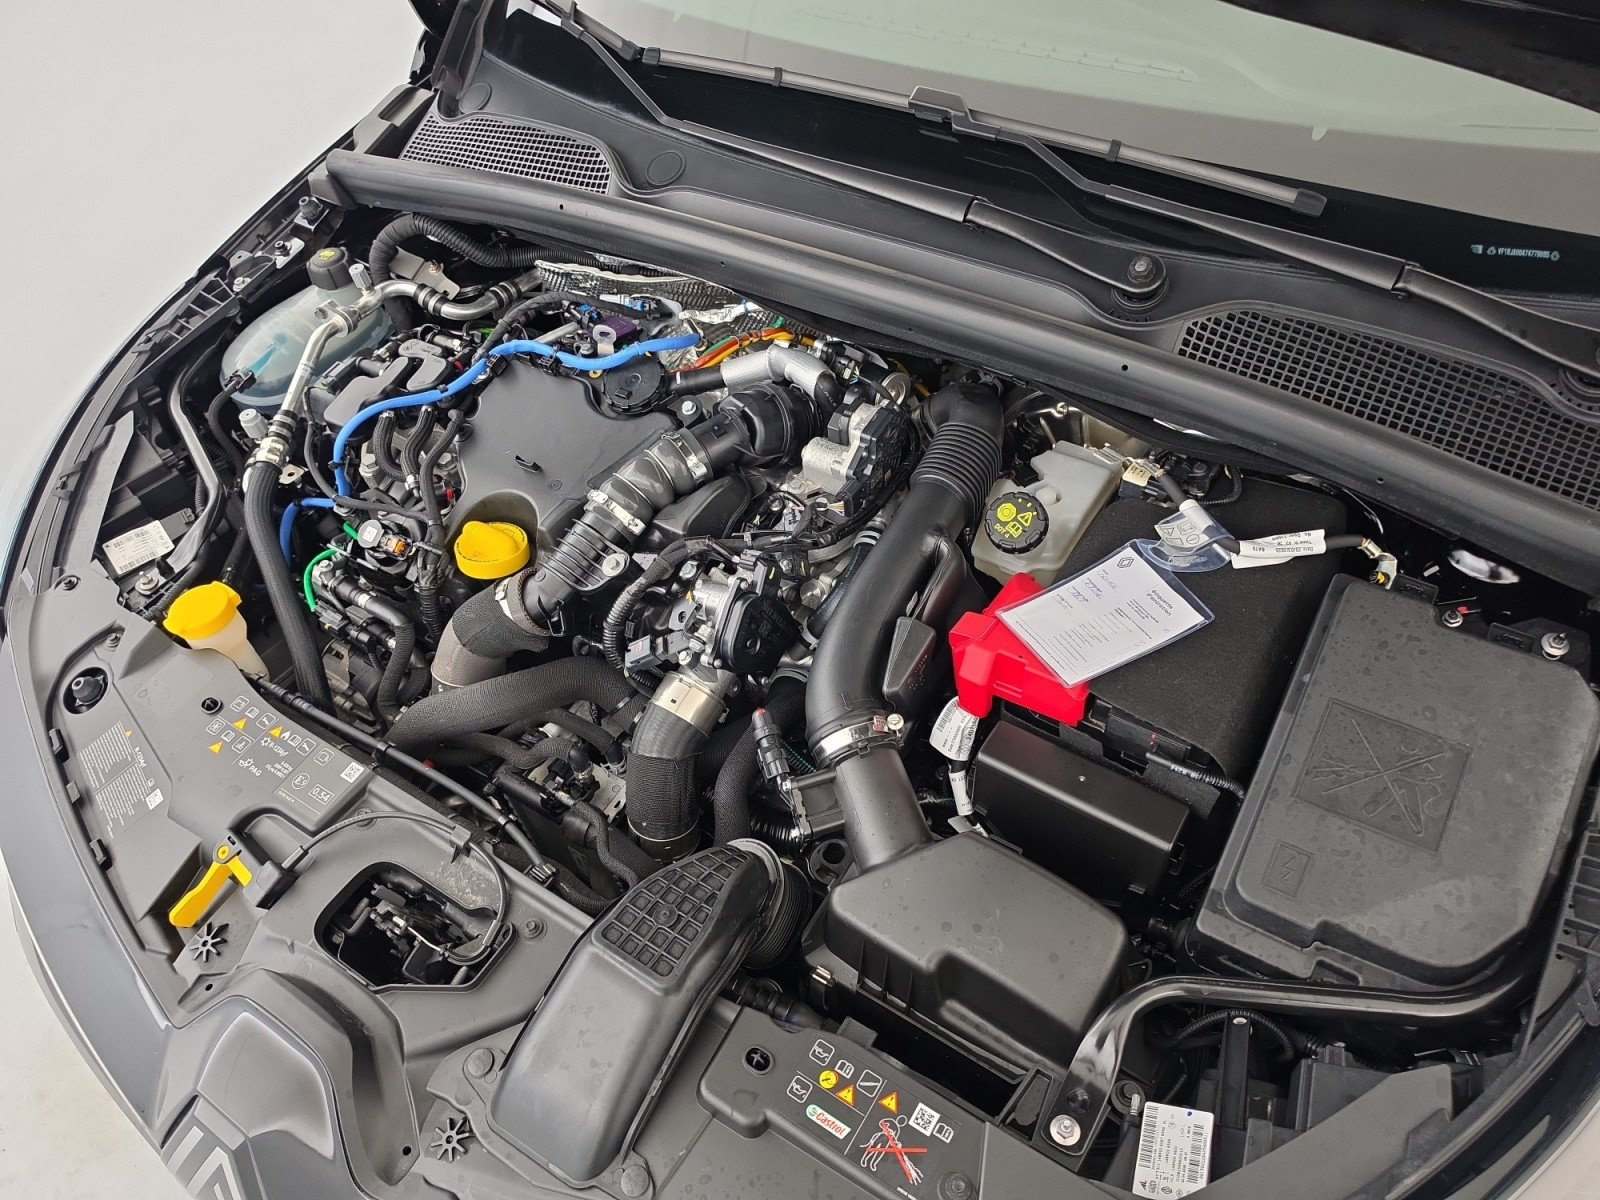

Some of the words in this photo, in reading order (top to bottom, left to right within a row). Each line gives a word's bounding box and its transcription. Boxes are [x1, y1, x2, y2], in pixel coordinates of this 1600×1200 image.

[995, 523, 1006, 534] DOT
[248, 765, 262, 777] PAG
[815, 1111, 846, 1138] Castrol
